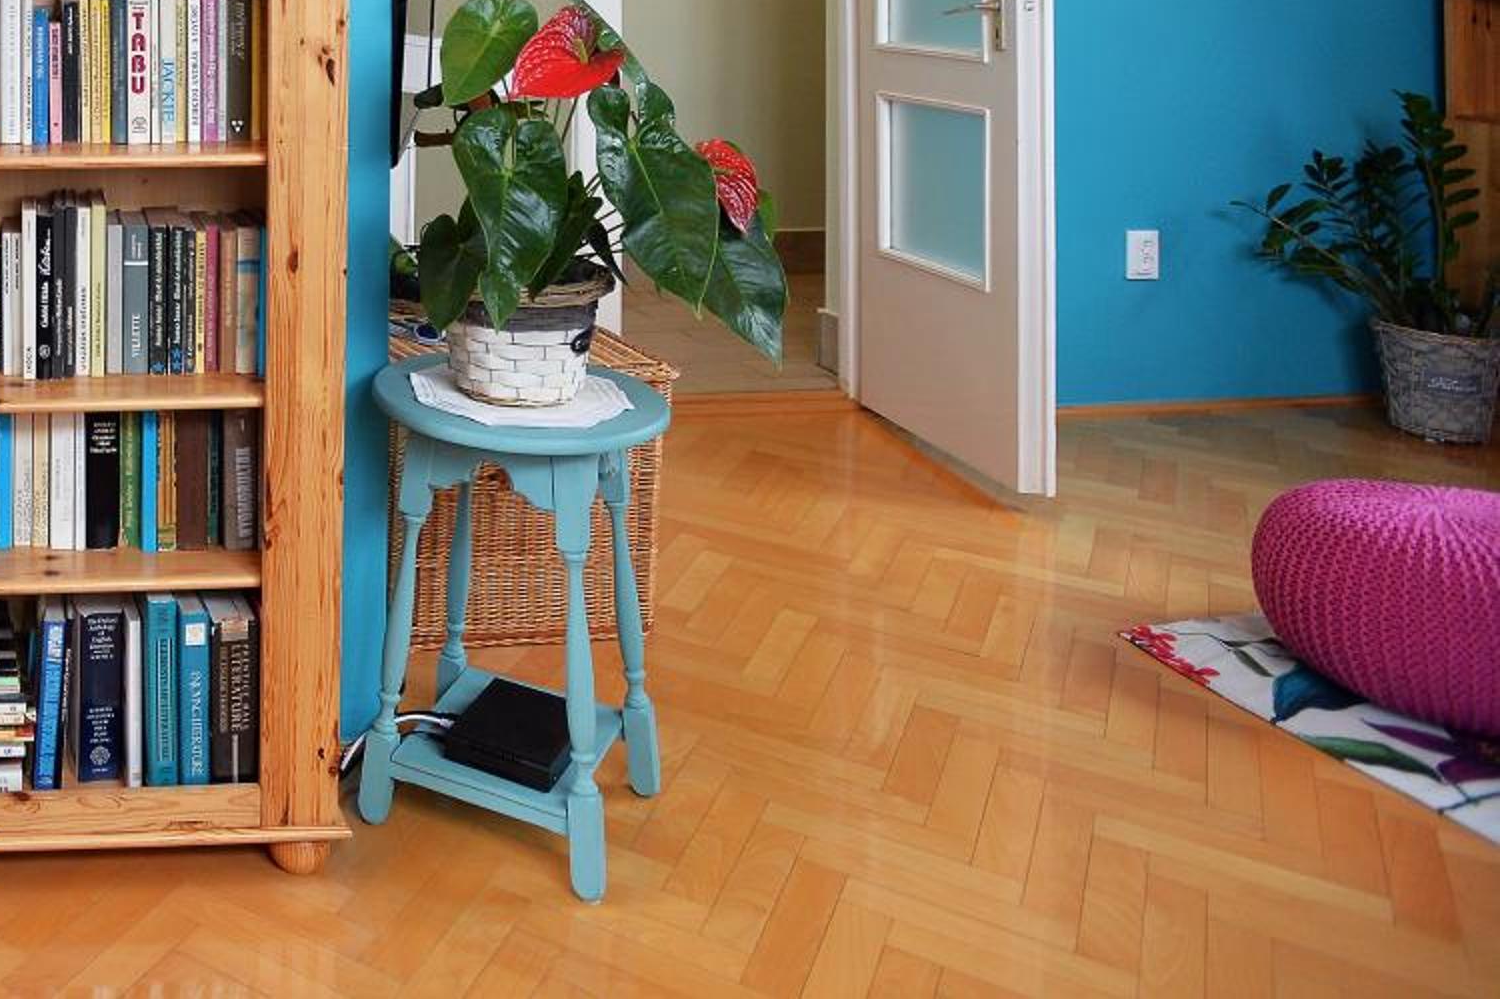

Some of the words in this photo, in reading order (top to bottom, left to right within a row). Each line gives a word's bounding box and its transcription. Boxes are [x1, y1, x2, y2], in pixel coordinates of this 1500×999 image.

[131, 12, 146, 95] TABU
[162, 58, 175, 122] JACKIE
[131, 314, 140, 357] VILLETTE
[231, 644, 242, 732] LITERATURE
